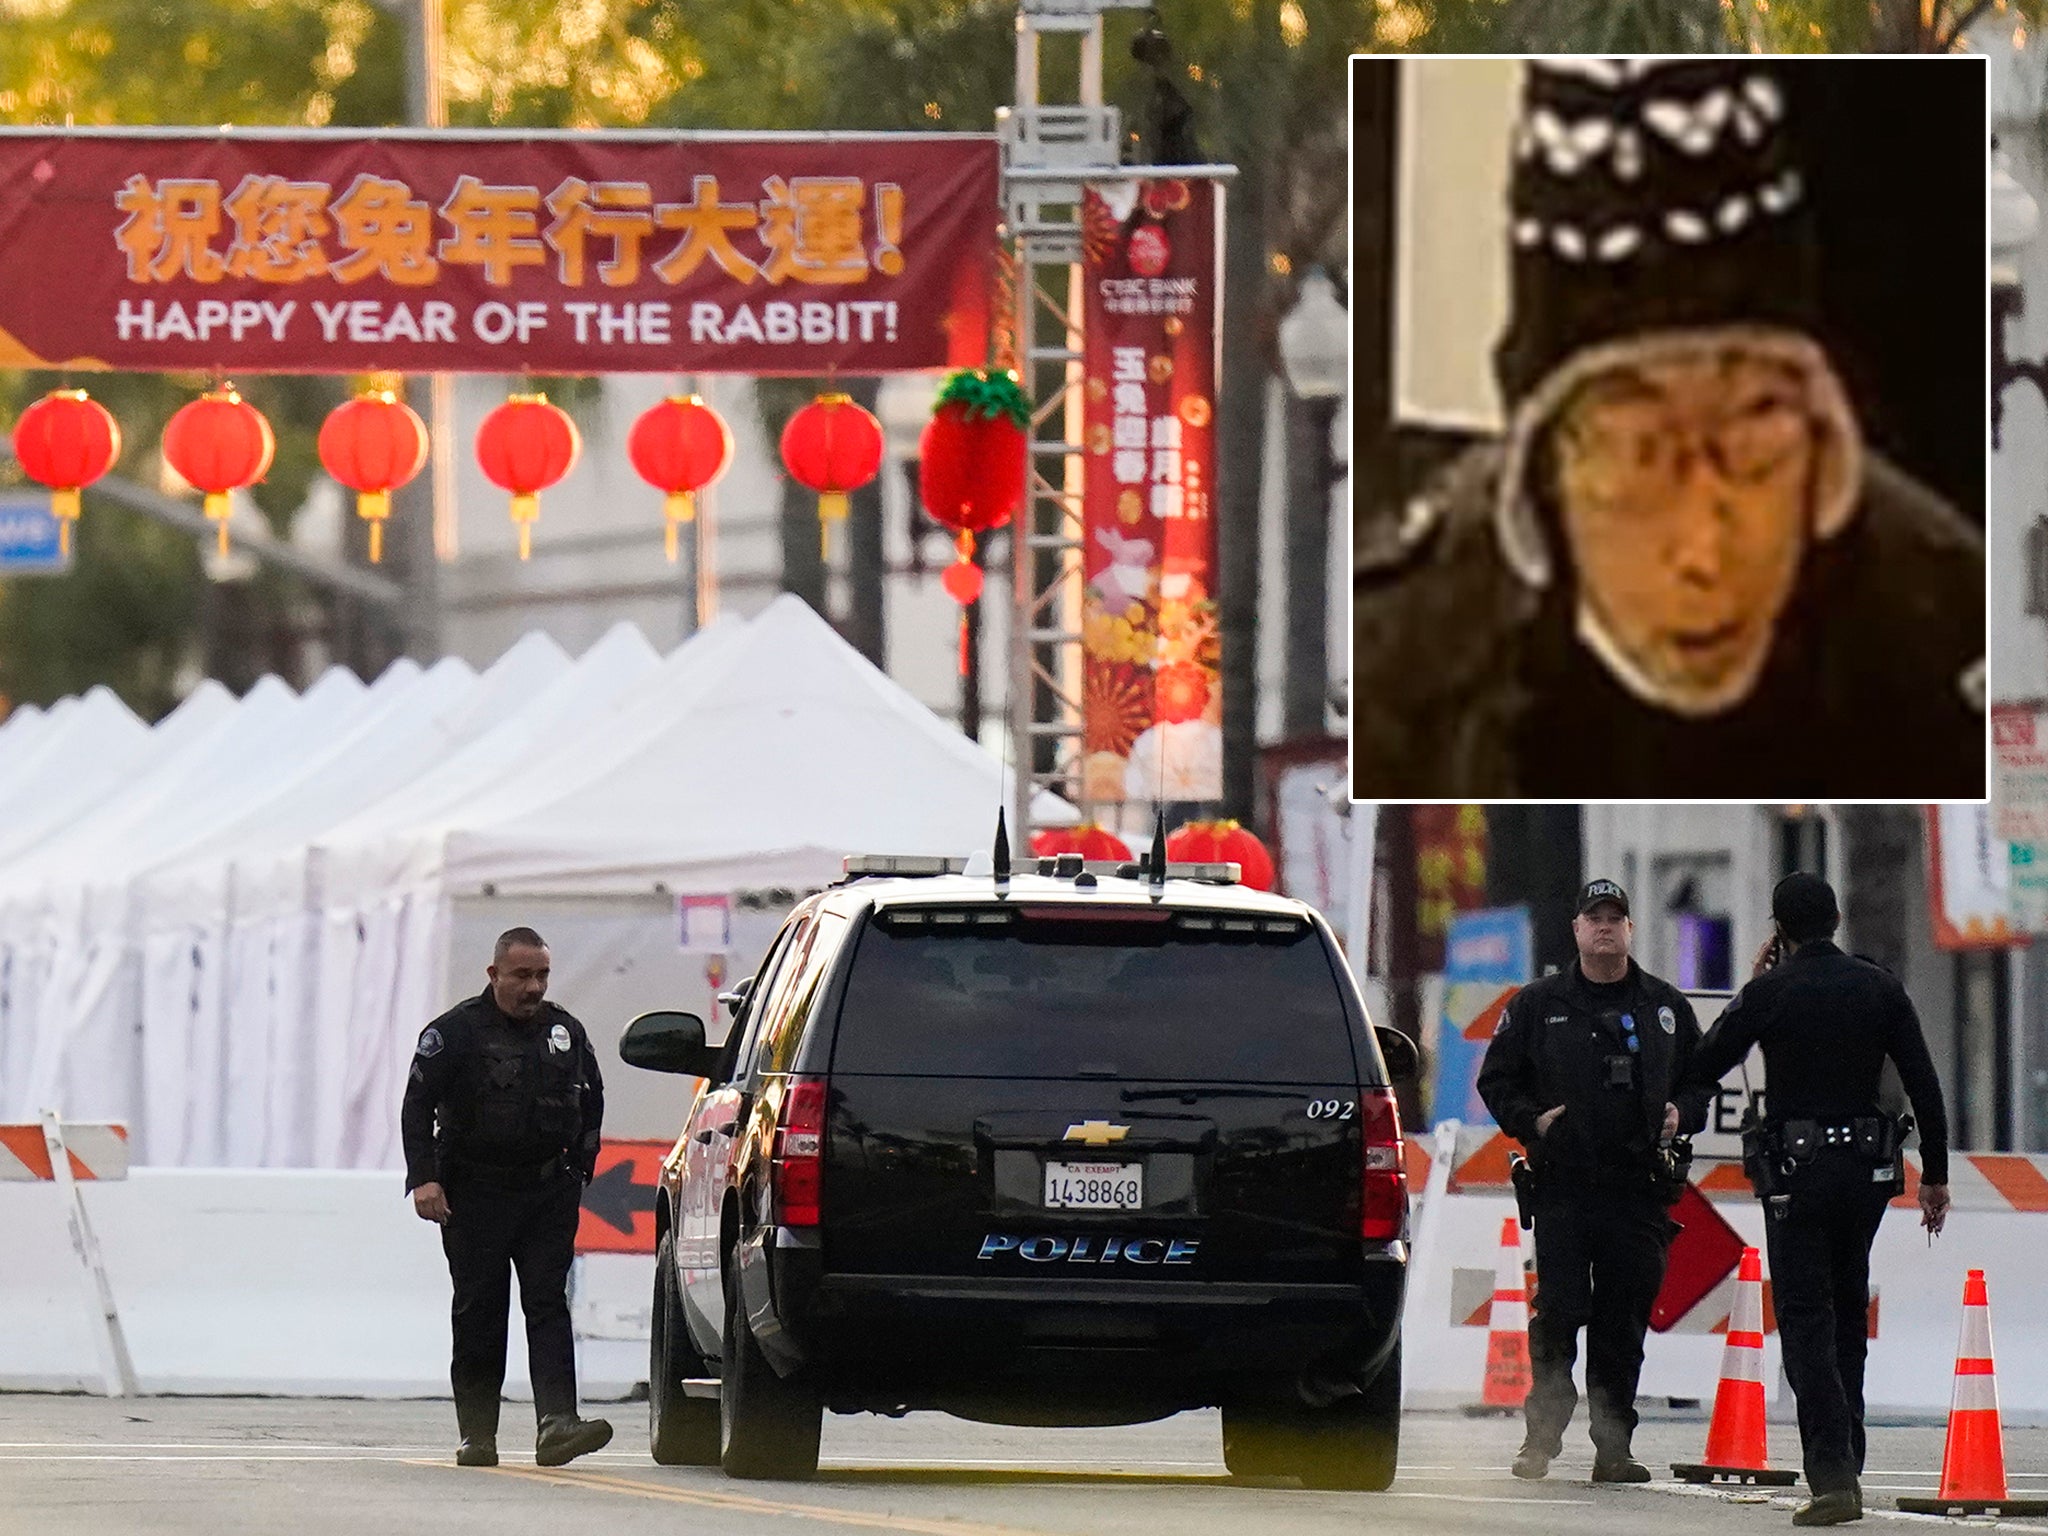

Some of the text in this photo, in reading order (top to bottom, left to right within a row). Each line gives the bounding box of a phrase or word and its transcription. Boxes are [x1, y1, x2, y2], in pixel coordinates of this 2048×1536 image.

[114, 172, 903, 287] 祝您兔年行大運!
[116, 299, 898, 344] HAPPY YEAR OF THE RABBIT!
[1306, 1099, 1355, 1120] 092
[1067, 1165, 1121, 1175] CA EXEMPT
[1049, 1178, 1138, 1204] 1438868
[976, 1232, 1200, 1265] POLICE
